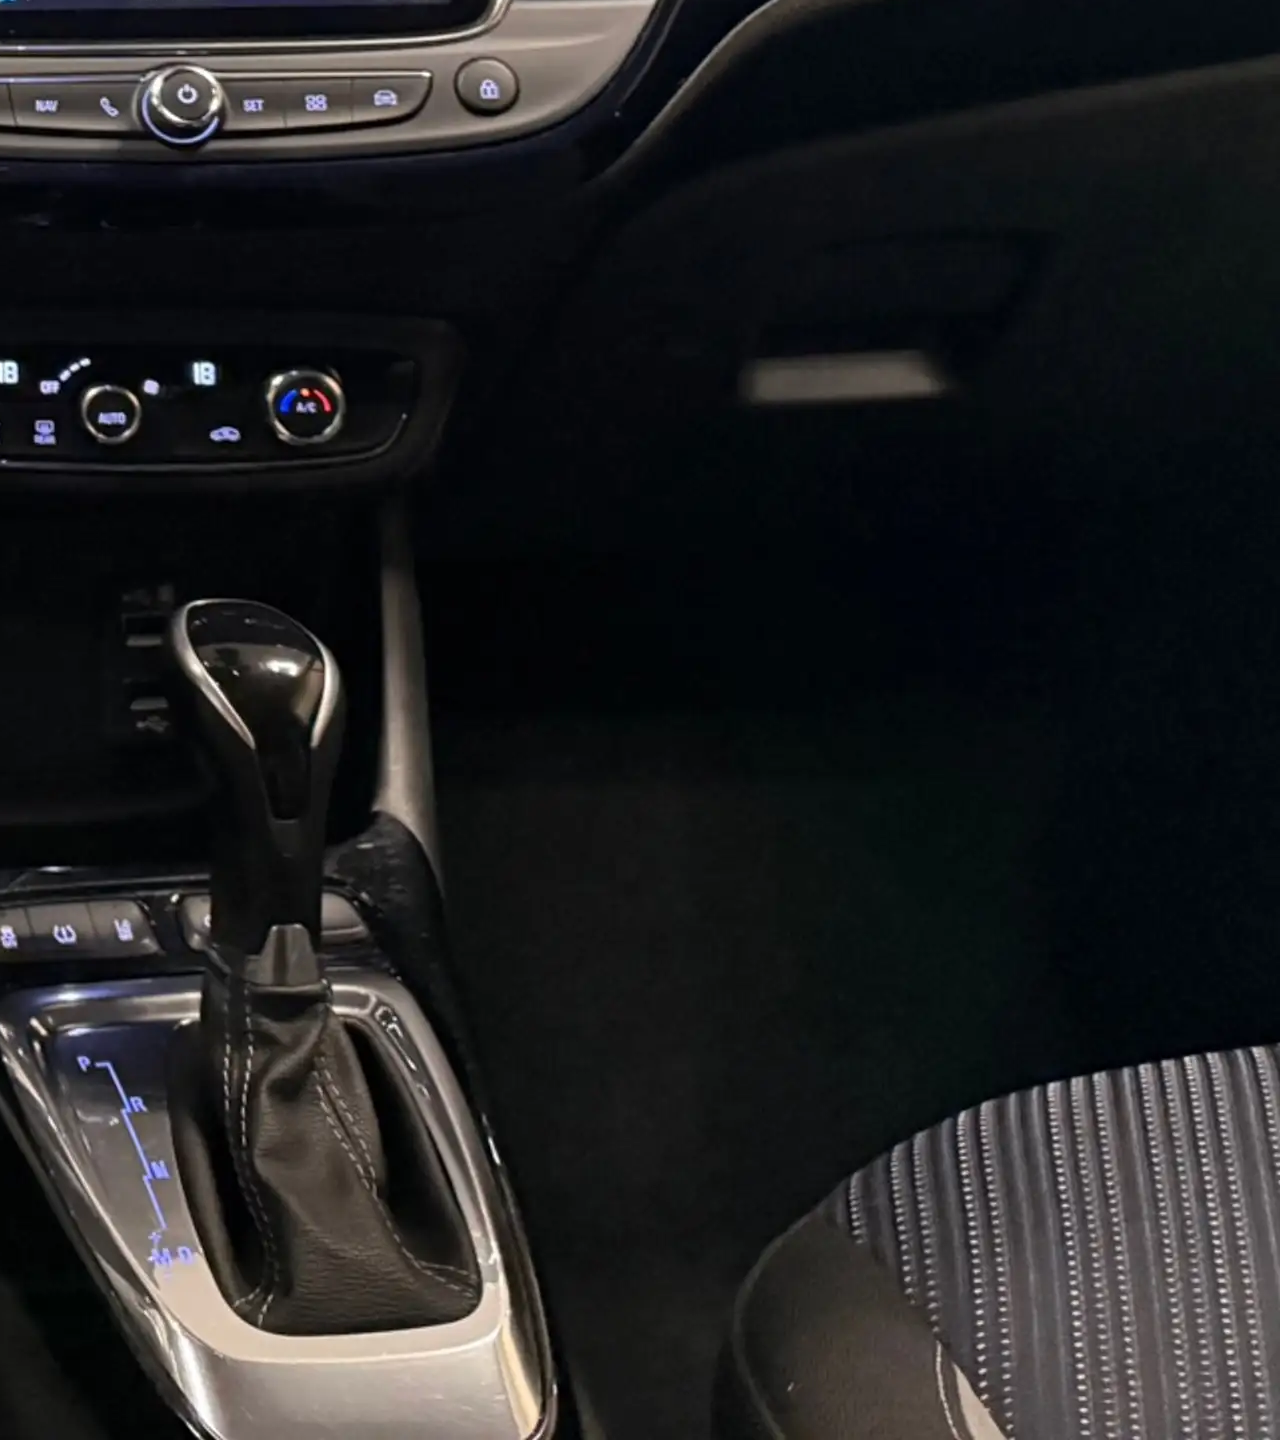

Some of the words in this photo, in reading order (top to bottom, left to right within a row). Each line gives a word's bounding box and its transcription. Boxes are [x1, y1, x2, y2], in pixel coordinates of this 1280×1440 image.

[35, 100, 59, 113] NAV
[243, 98, 265, 113] SET
[192, 361, 216, 386] 18
[76, 1055, 91, 1073] P
[130, 1096, 149, 1113] R
